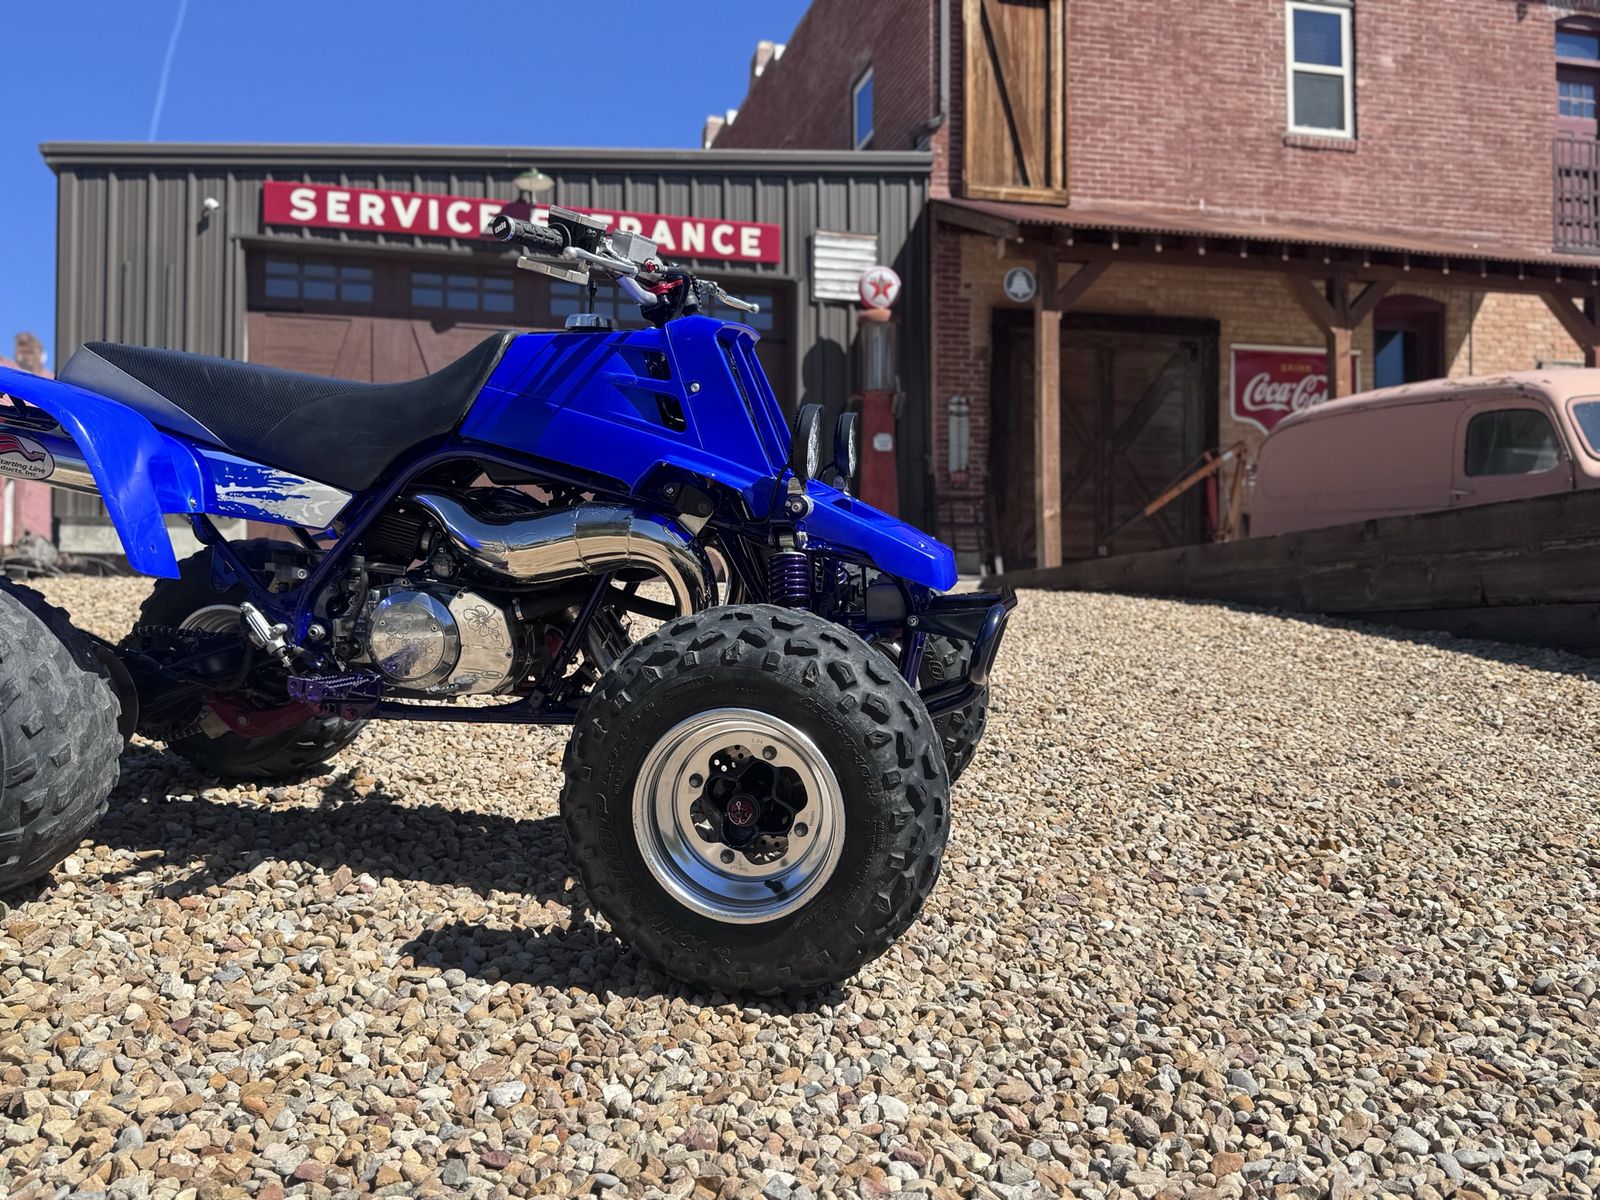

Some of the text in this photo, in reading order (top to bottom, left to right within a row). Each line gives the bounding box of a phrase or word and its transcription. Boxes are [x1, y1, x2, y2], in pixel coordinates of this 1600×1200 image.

[290, 188, 762, 257] SERVICE ERANCE
[1243, 371, 1328, 412] Coca-Co
[0, 458, 46, 474] tarting Line
[25, 470, 39, 478] Inc.
